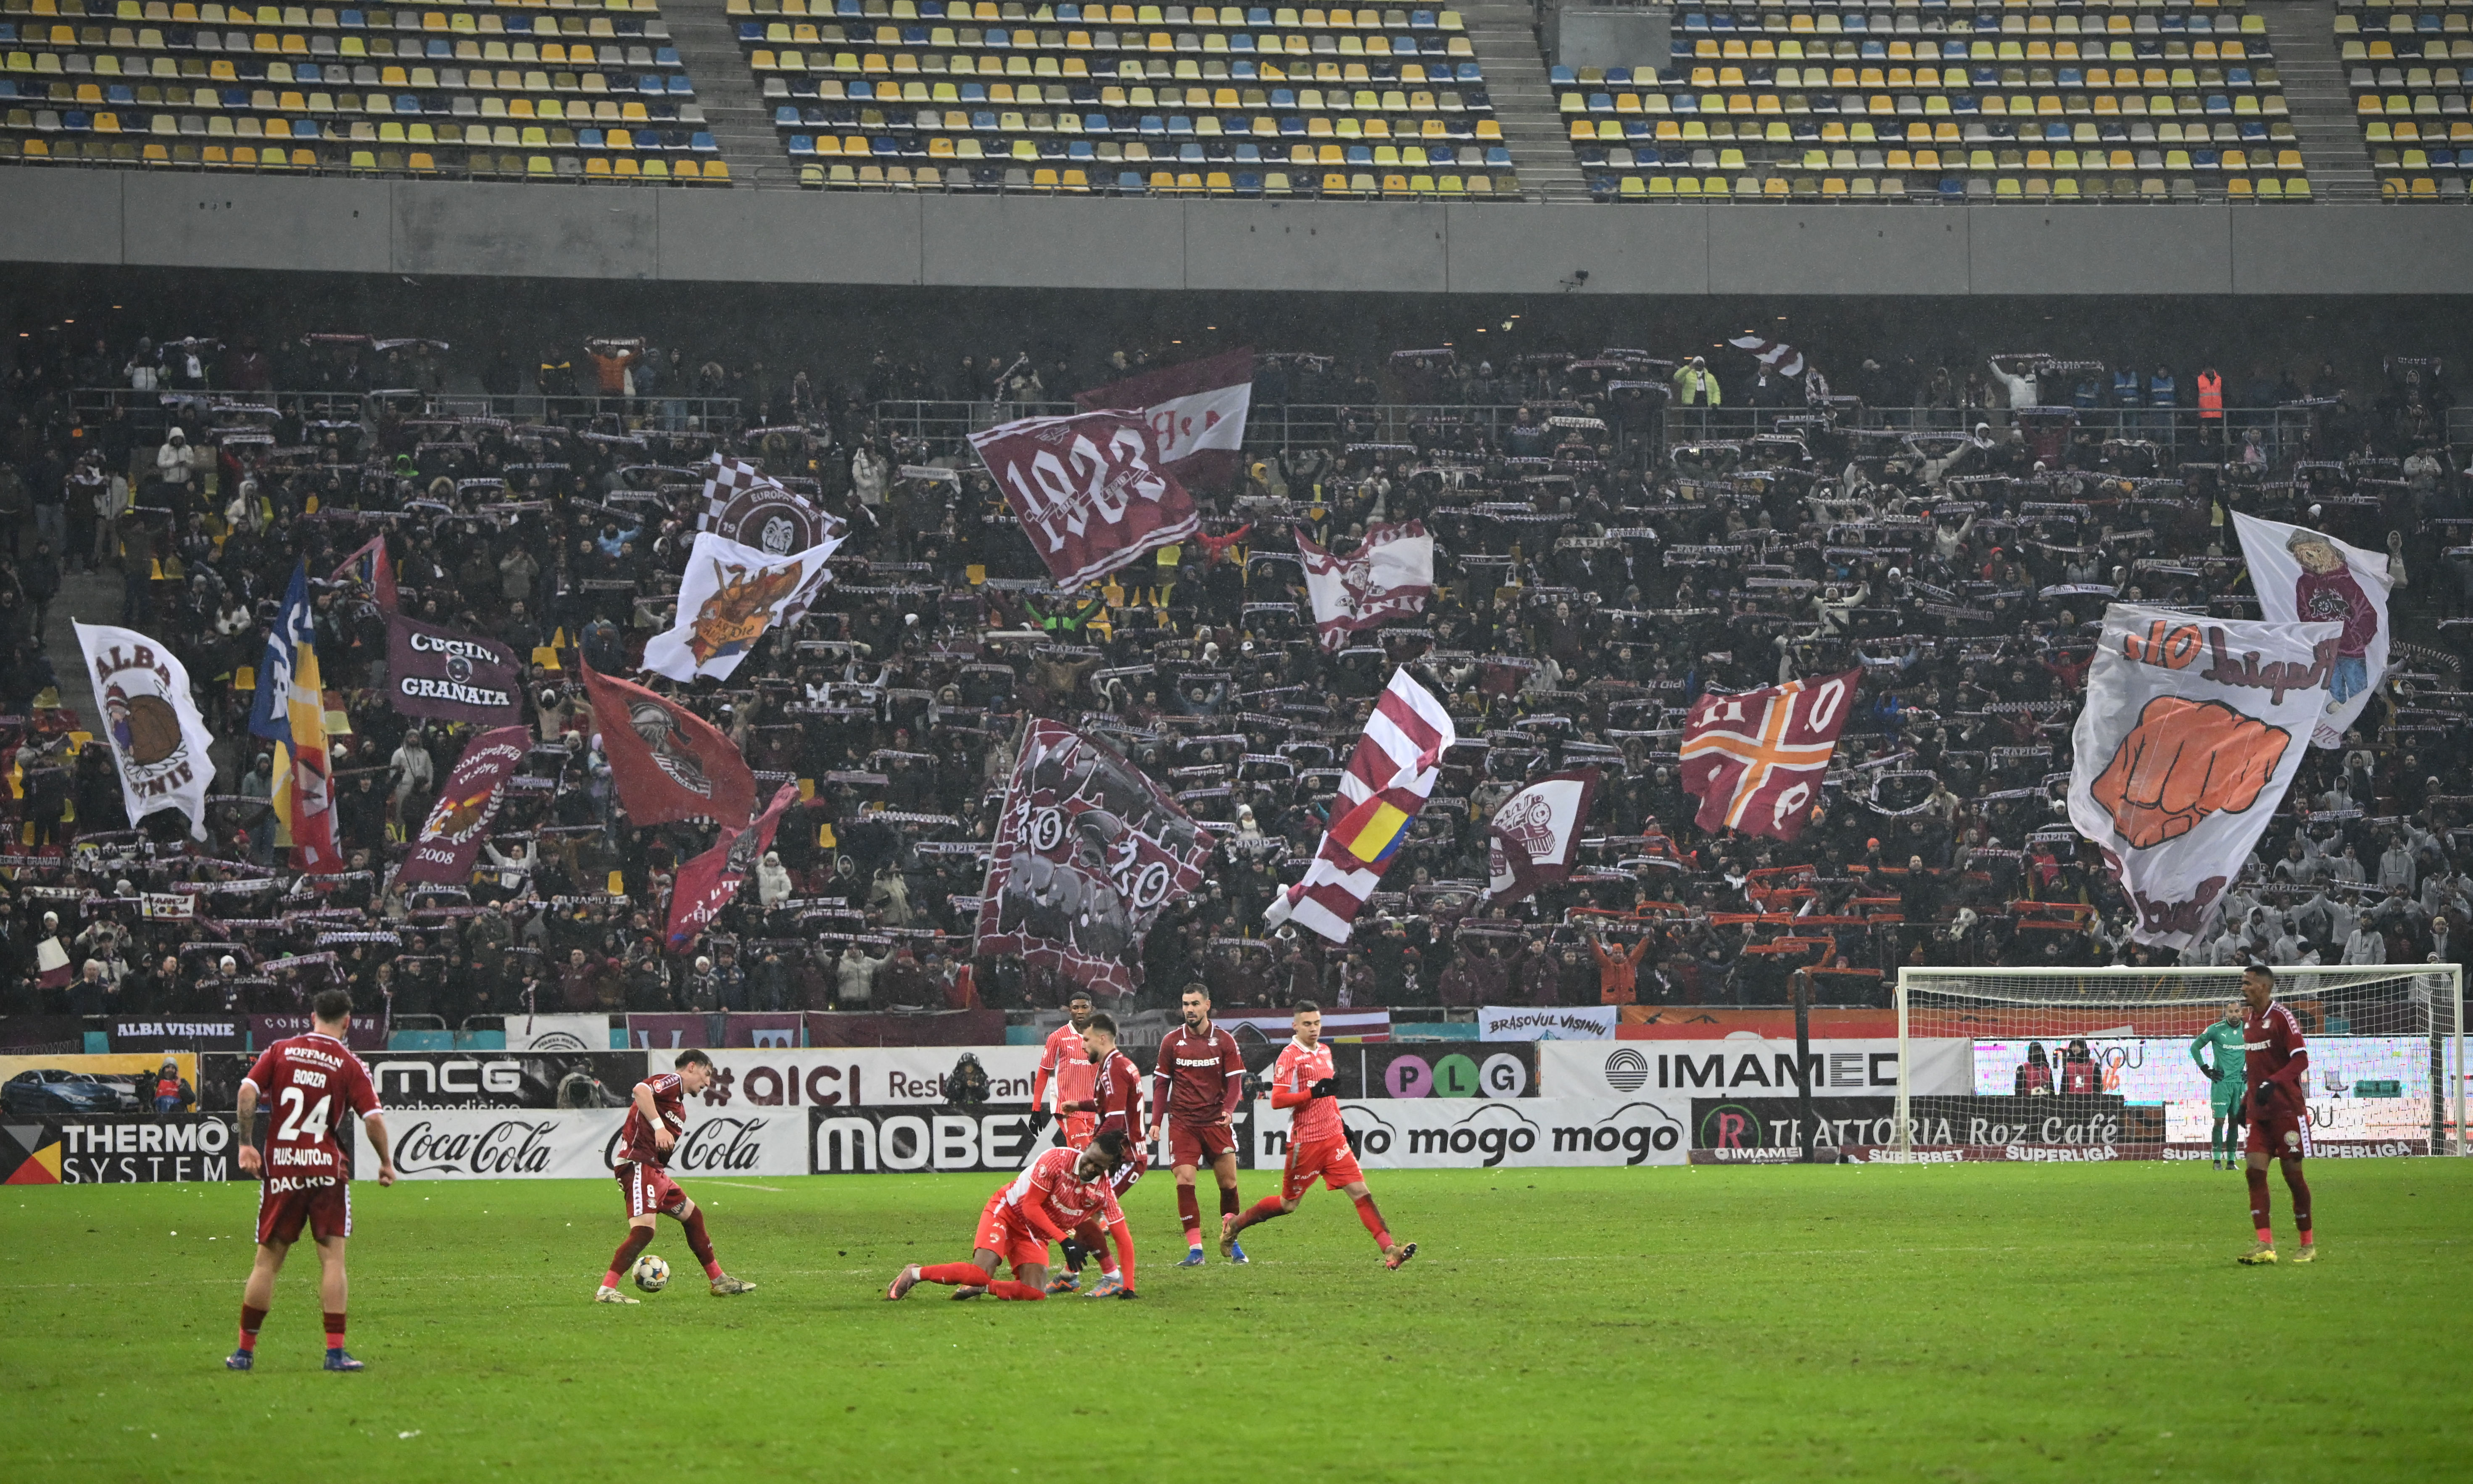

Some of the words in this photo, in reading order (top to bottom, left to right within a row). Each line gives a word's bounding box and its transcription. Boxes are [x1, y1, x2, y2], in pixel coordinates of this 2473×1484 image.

[2291, 398, 2323, 406] RAPID
[1049, 644, 1084, 654] RAPID
[95, 644, 171, 687] ALBA
[401, 677, 510, 706] GRANATA
[939, 843, 975, 852] RAPID
[1236, 839, 1270, 848] RAPID
[27, 856, 61, 866] GRANATA
[416, 847, 455, 865] 2008
[575, 896, 606, 904] RAPID
[117, 1023, 165, 1037] ALBA
[2245, 1039, 2271, 1051] UPERBET
[1176, 1056, 1220, 1068] SUPERBET
[1658, 1052, 1899, 1088] IMAMED
[293, 1068, 327, 1089] BORZA
[277, 1086, 332, 1144] 24
[63, 1116, 229, 1155] THERMO
[1969, 1117, 2028, 1146] Roz
[2041, 1113, 2118, 1145] Café
[393, 1120, 561, 1175] Coca-Cola
[1408, 1127, 1535, 1167] mogo
[1552, 1126, 1679, 1166] mogo
[2006, 1145, 2118, 1162] SUPERLIGA
[2313, 1140, 2412, 1159] UPERLIGA
[273, 1148, 333, 1167] PLUS-AUTO.ro
[63, 1156, 227, 1184] SYSTEM
[270, 1176, 336, 1195] DACRIS
[646, 1184, 655, 1198] 8
